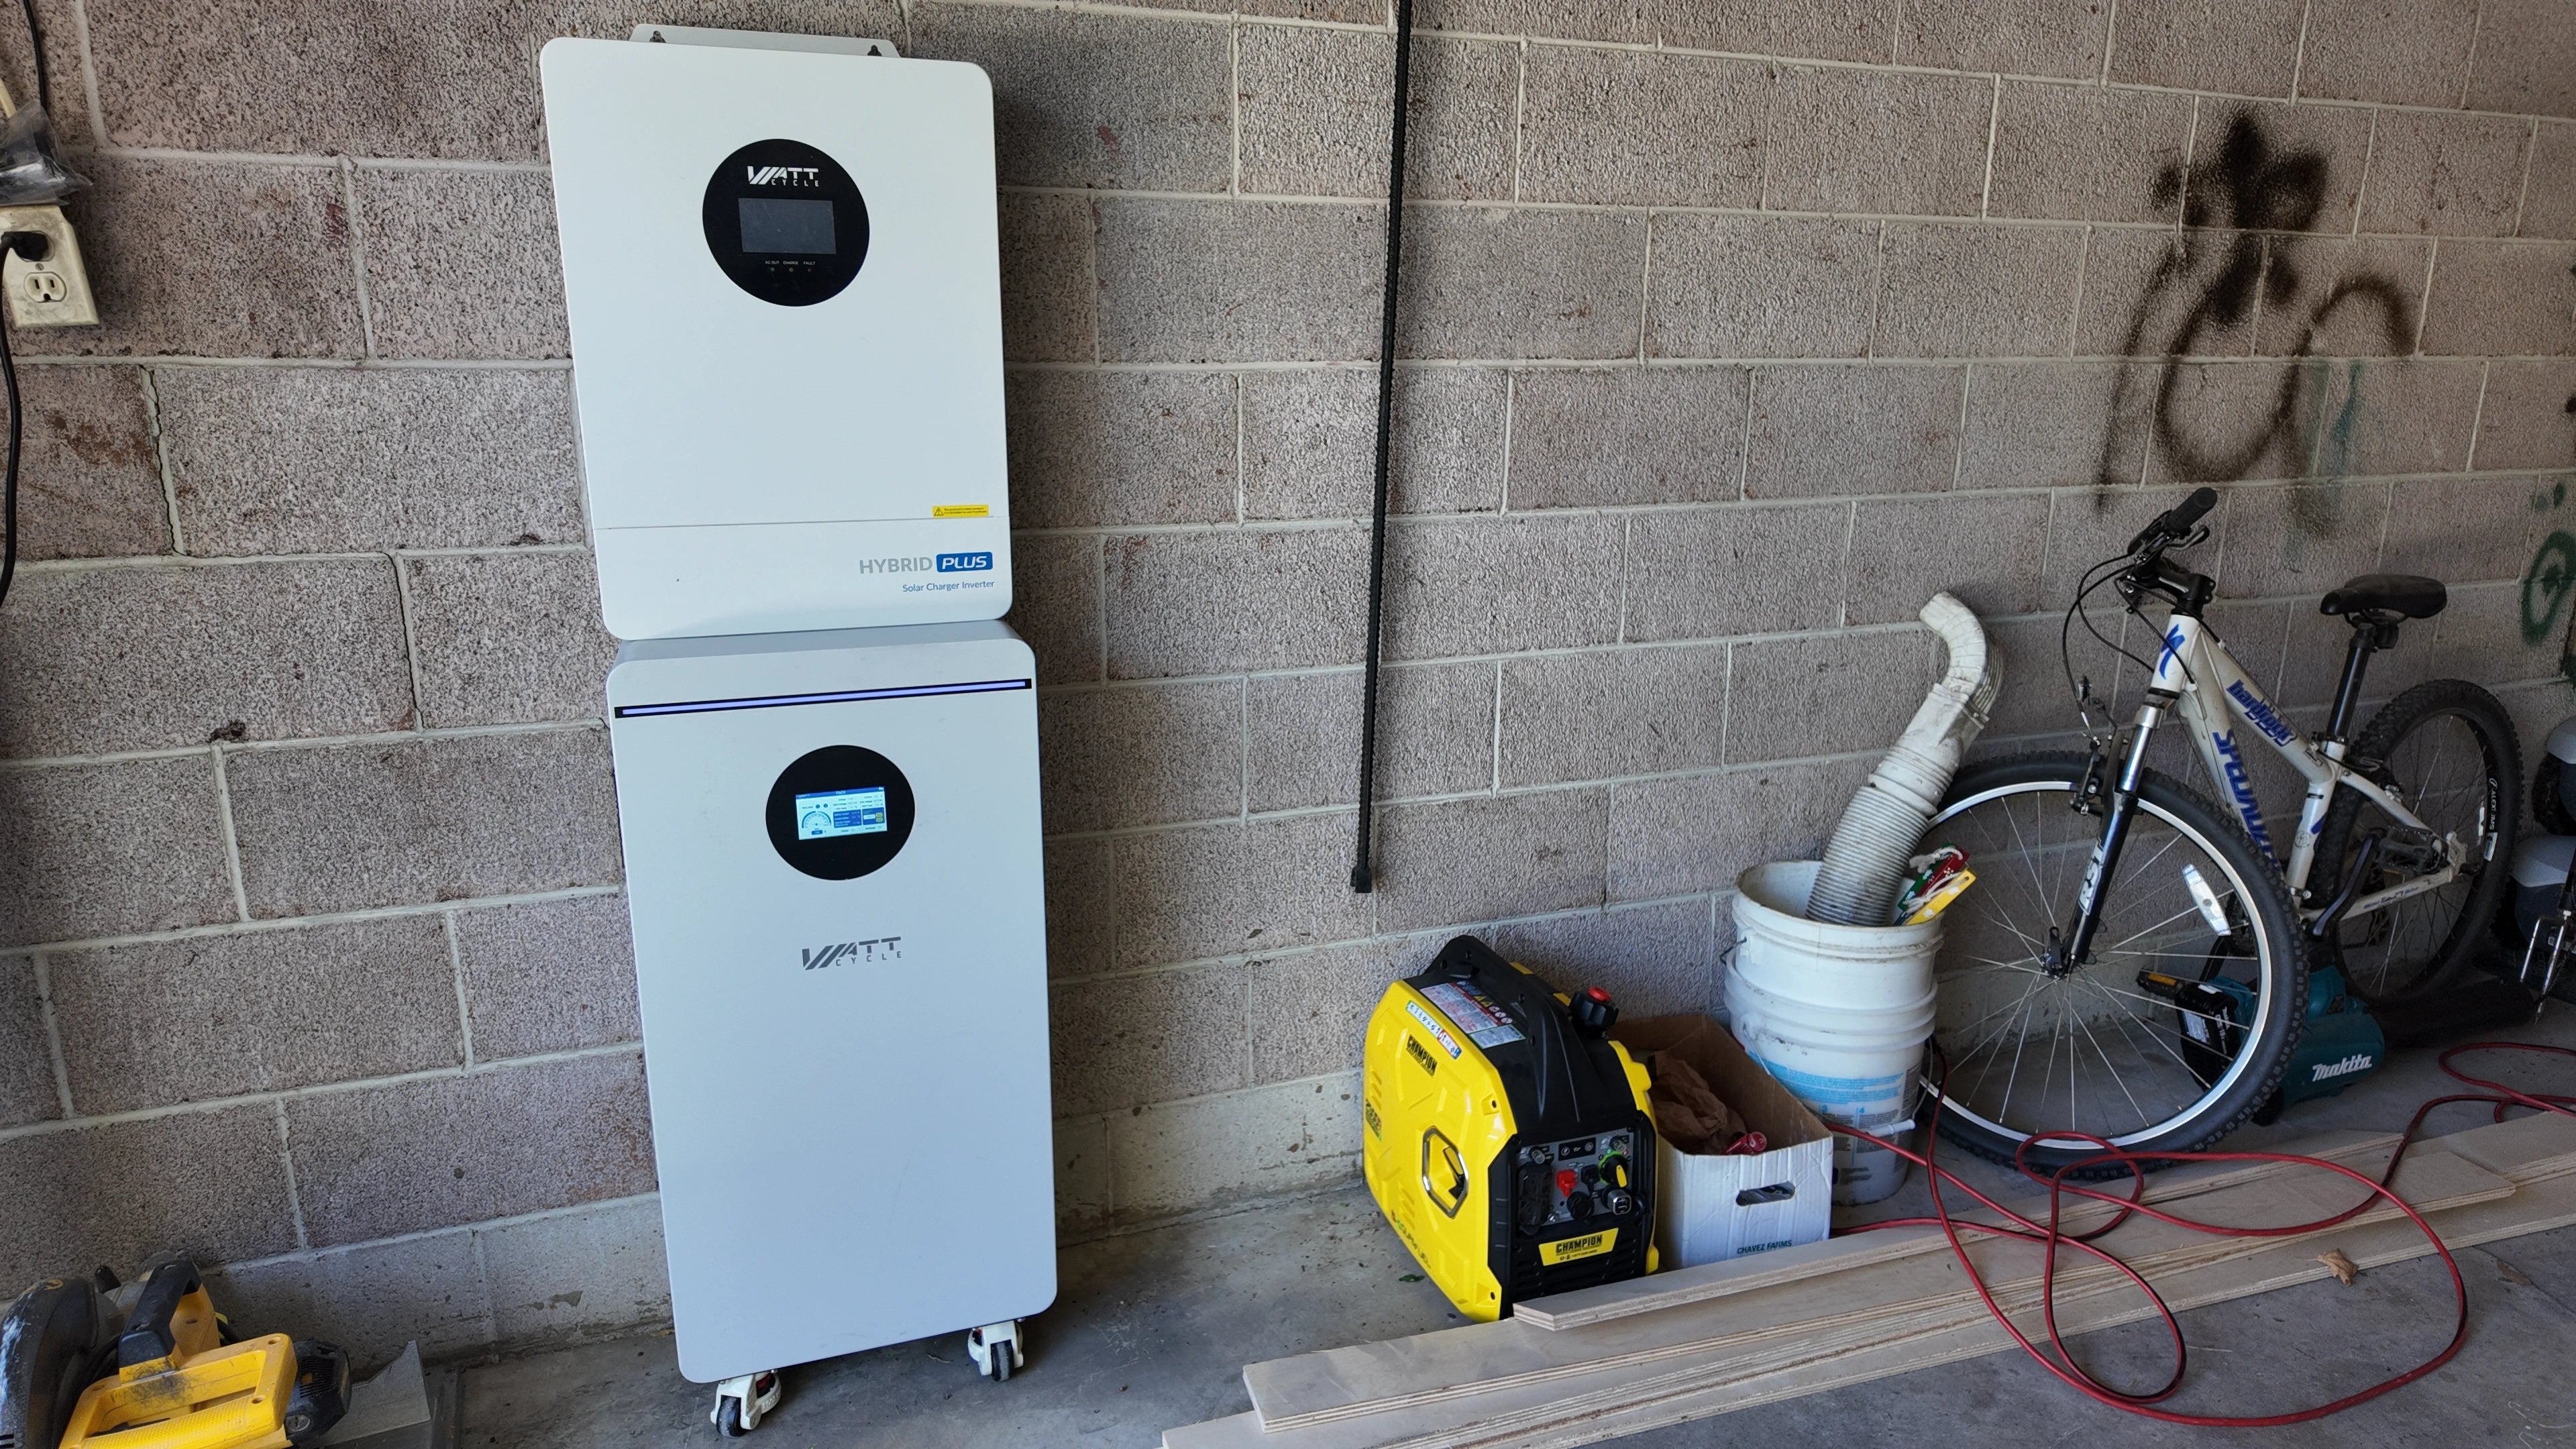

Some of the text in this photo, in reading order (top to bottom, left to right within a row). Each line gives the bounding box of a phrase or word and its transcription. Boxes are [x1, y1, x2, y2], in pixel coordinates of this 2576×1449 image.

[747, 166, 818, 185] WATT
[771, 179, 819, 187] CYCLE
[859, 555, 987, 574] HYBRID PLUS
[902, 580, 995, 592] Solar Charger Inverter
[802, 936, 902, 970] WATT
[835, 951, 902, 967] CYCLE
[1407, 1034, 1438, 1074] CHAMPION
[1556, 1234, 1603, 1253] CHAMPION
[1737, 1240, 1792, 1254] CHAVEZ FARMS
